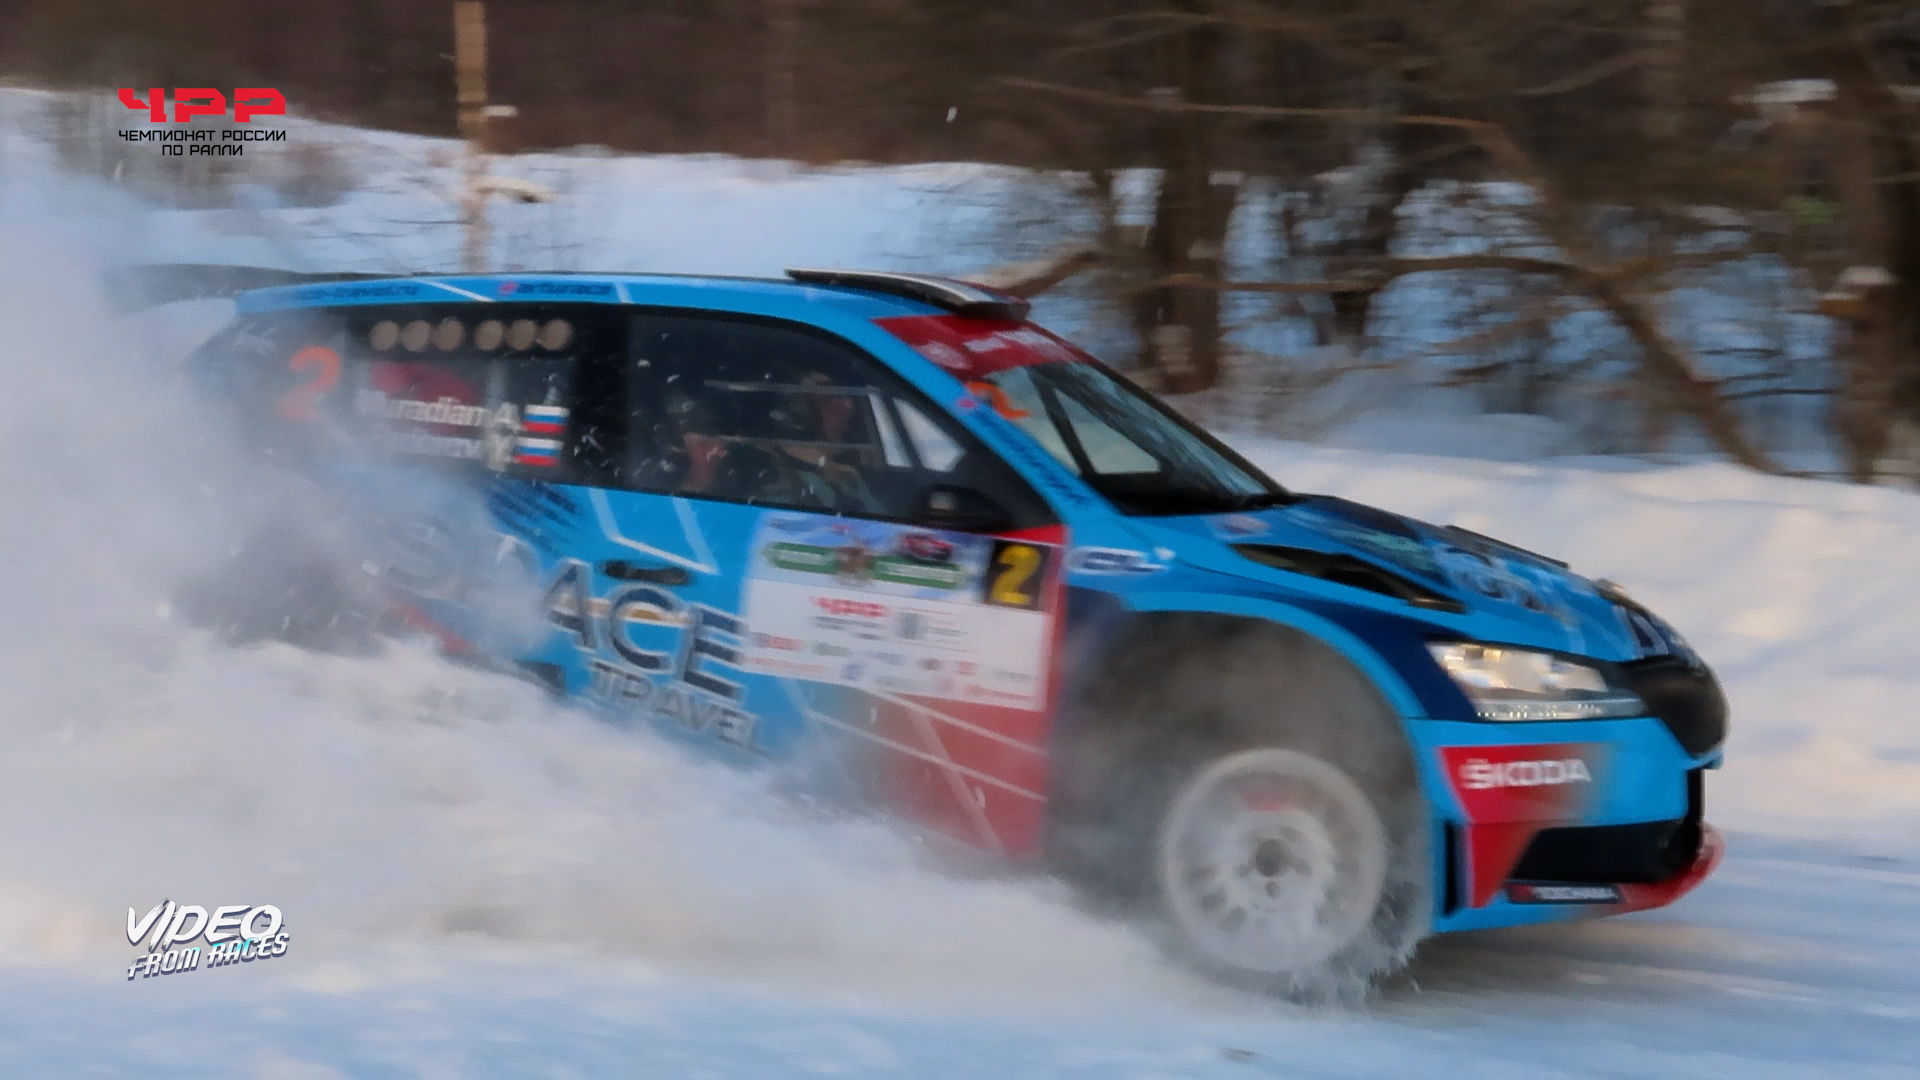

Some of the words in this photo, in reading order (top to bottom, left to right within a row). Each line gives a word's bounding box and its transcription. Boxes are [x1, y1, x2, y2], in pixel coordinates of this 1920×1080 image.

[275, 345, 341, 421] 2
[991, 545, 1041, 605] 2
[586, 656, 771, 757] TRAVEL
